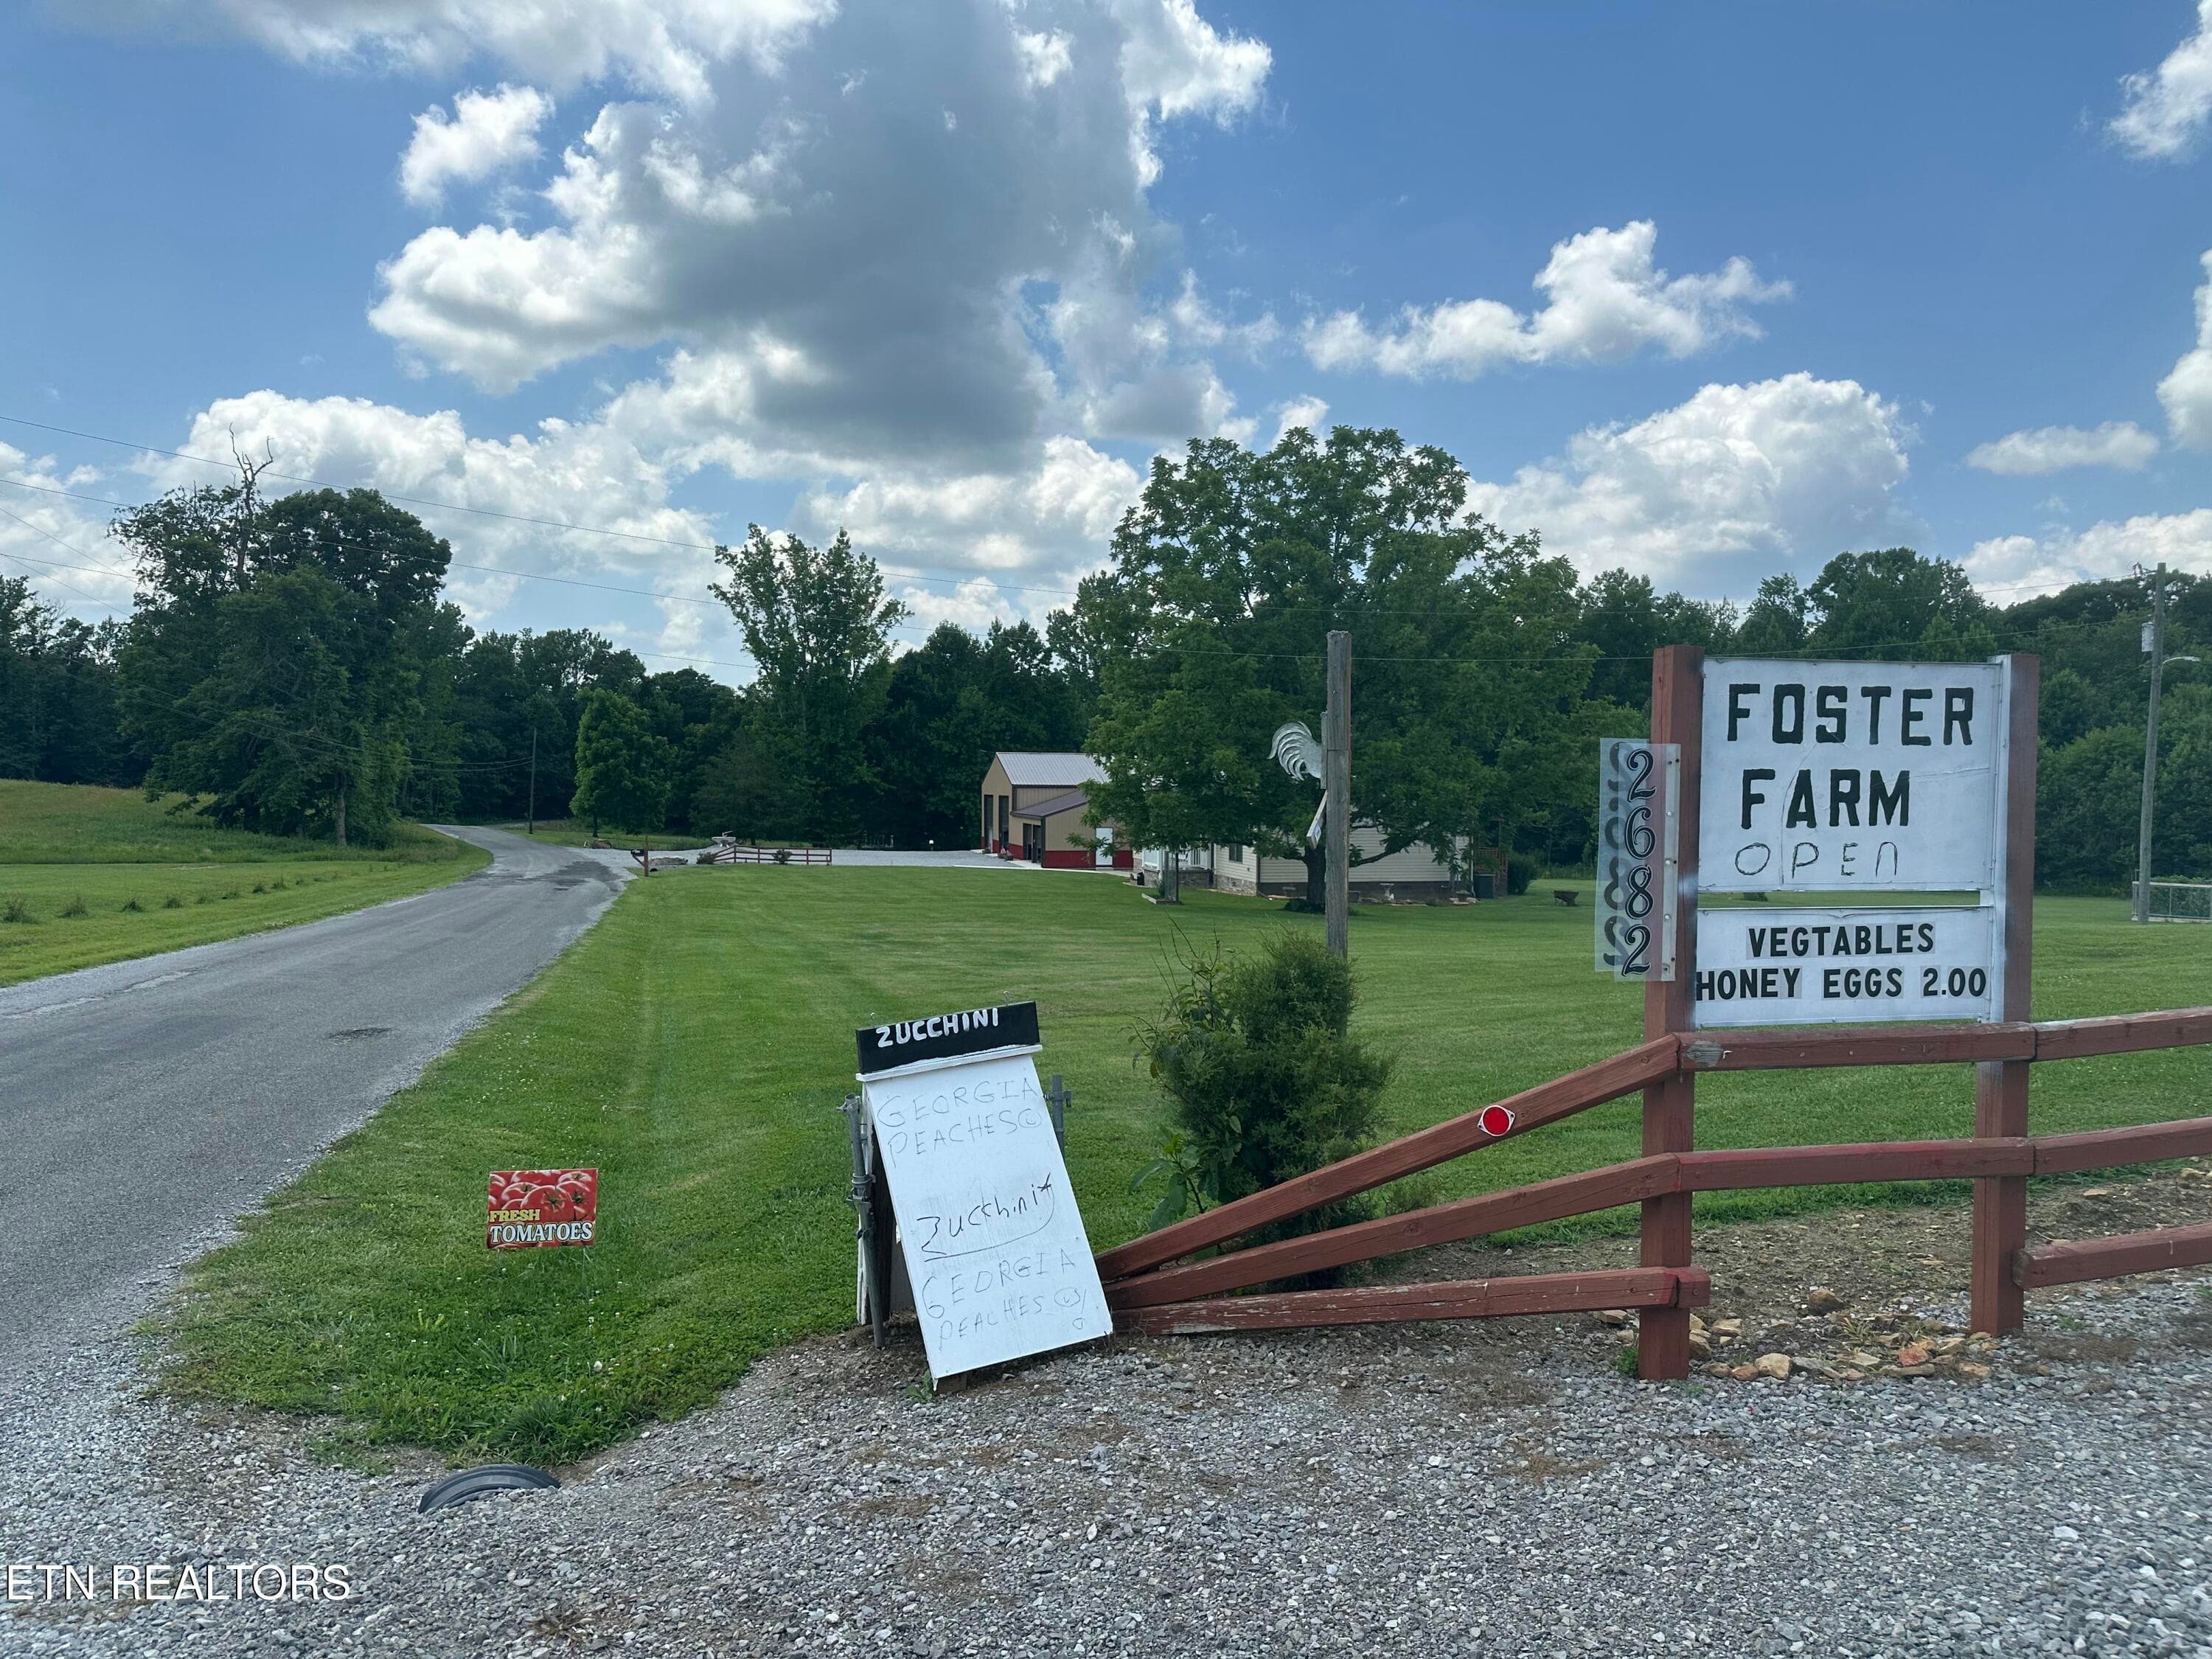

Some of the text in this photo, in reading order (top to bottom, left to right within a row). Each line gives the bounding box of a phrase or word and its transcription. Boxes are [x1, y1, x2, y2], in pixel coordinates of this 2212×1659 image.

[1727, 682, 1975, 746] FOSTER
[1741, 768, 1911, 830] FARM
[1621, 748, 1657, 977] 2682
[1747, 922, 1935, 957] VEGTABLES
[1696, 967, 1986, 1001] HONEY EGGS 2.00
[875, 1006, 999, 1048] ZUCCHINI
[877, 1077, 1038, 1127] GEORGIA
[489, 1208, 541, 1222] FRESH
[489, 1221, 594, 1244] TOMATOES
[922, 1248, 1077, 1319] GEORGIA
